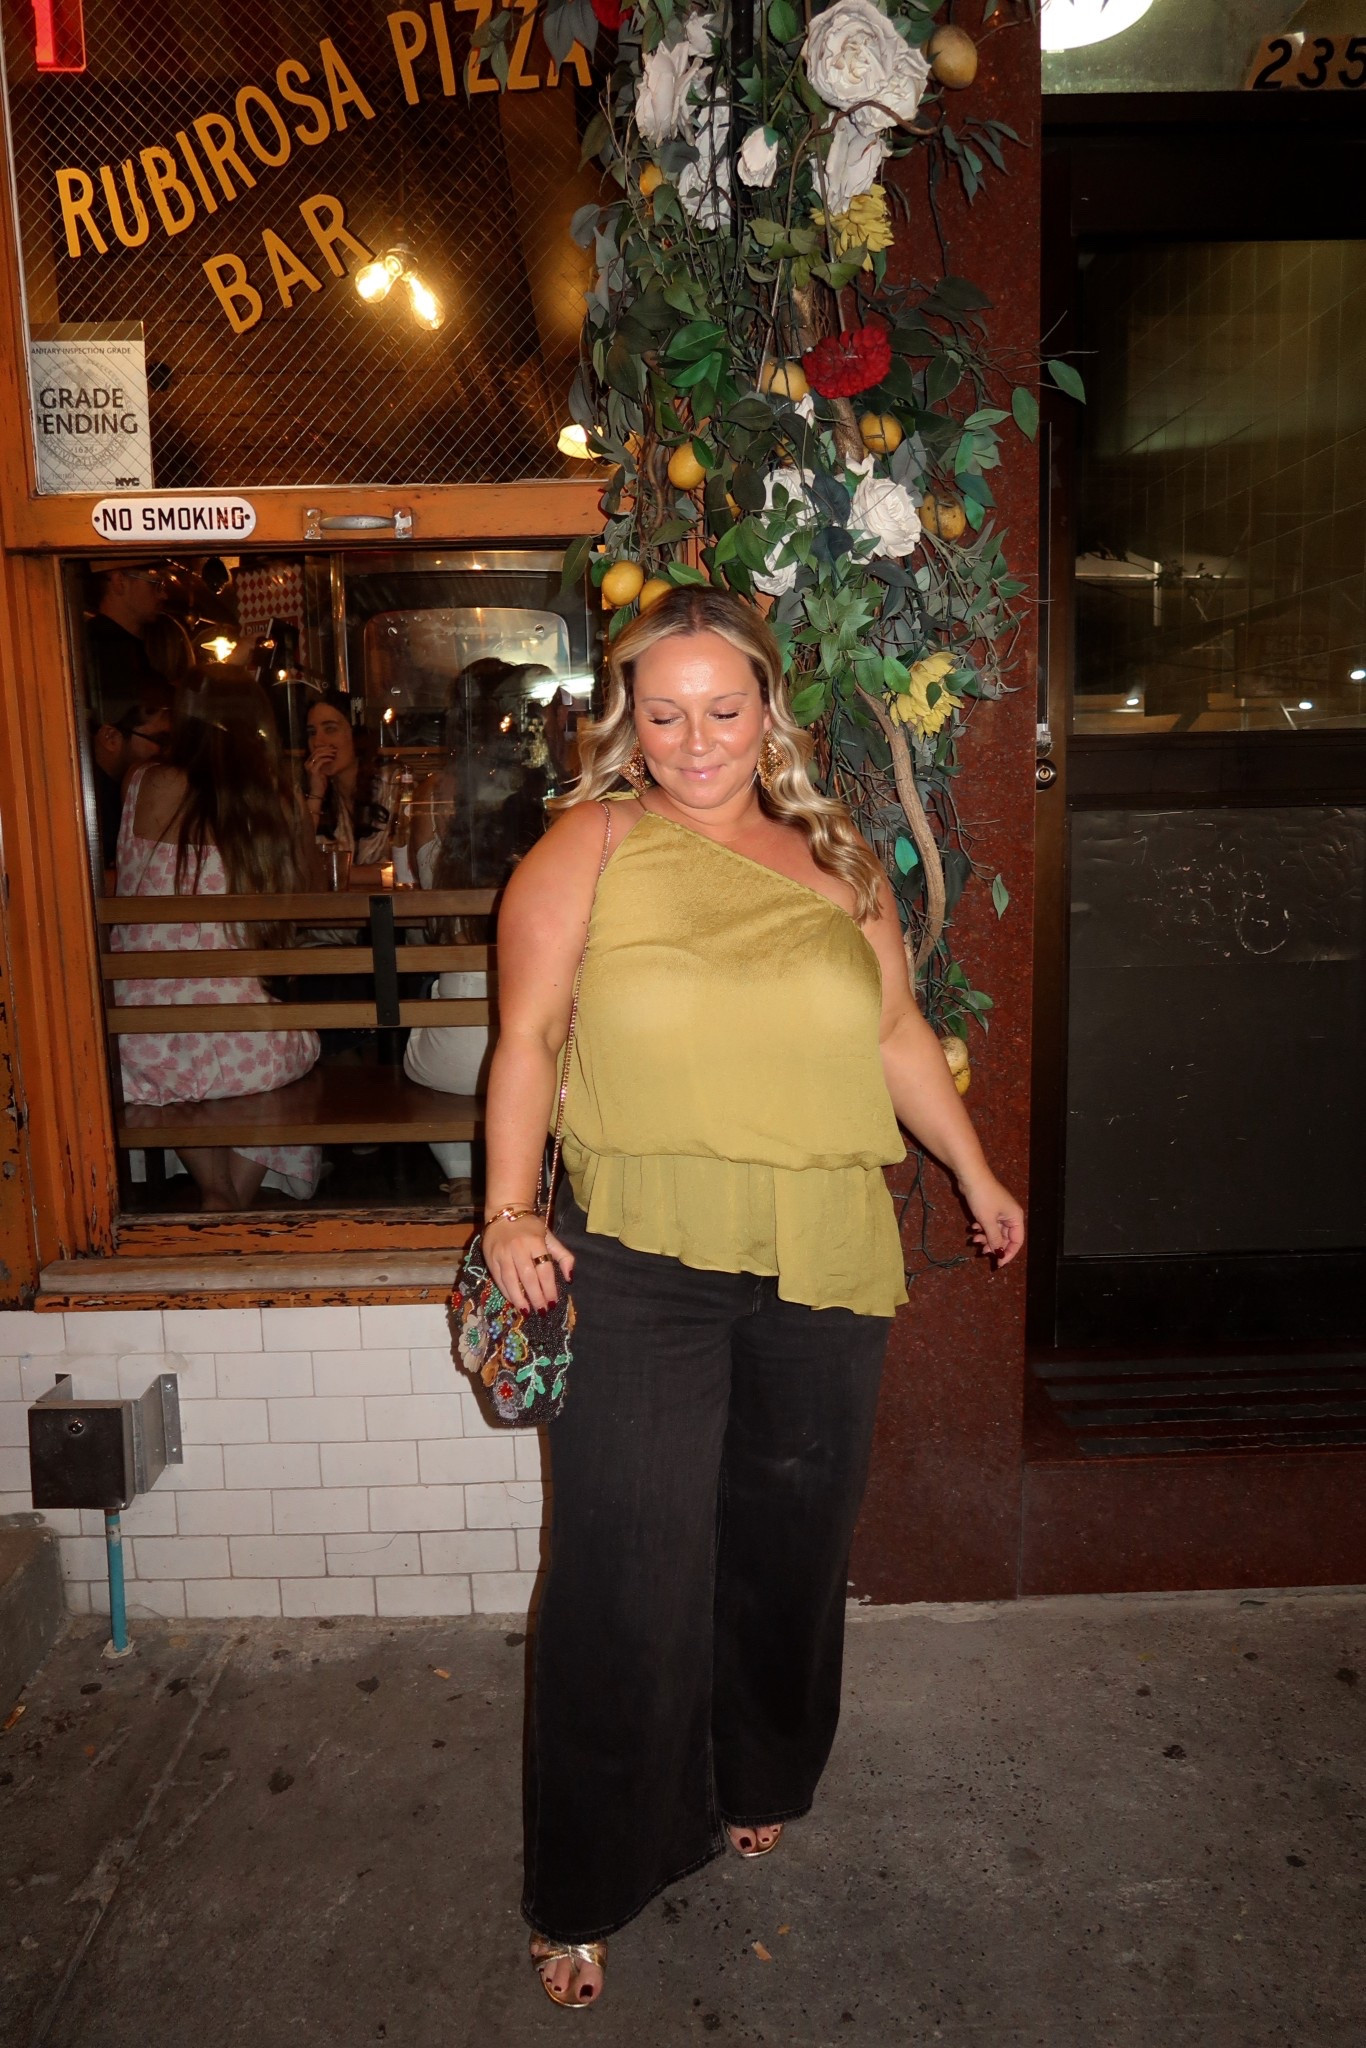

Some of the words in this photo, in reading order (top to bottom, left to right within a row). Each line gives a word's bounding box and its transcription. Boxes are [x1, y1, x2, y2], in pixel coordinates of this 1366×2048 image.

[1252, 37, 1366, 90] 235
[55, 38, 376, 258] RUBIROSA
[202, 194, 375, 334] BAR
[31, 347, 61, 355] ANITARY
[62, 347, 105, 355] INSPECTION
[106, 346, 131, 354] GRADE
[40, 388, 124, 409] GRADE
[115, 477, 140, 487] NYC
[102, 508, 132, 531] NO
[142, 507, 245, 531] SMOKING
